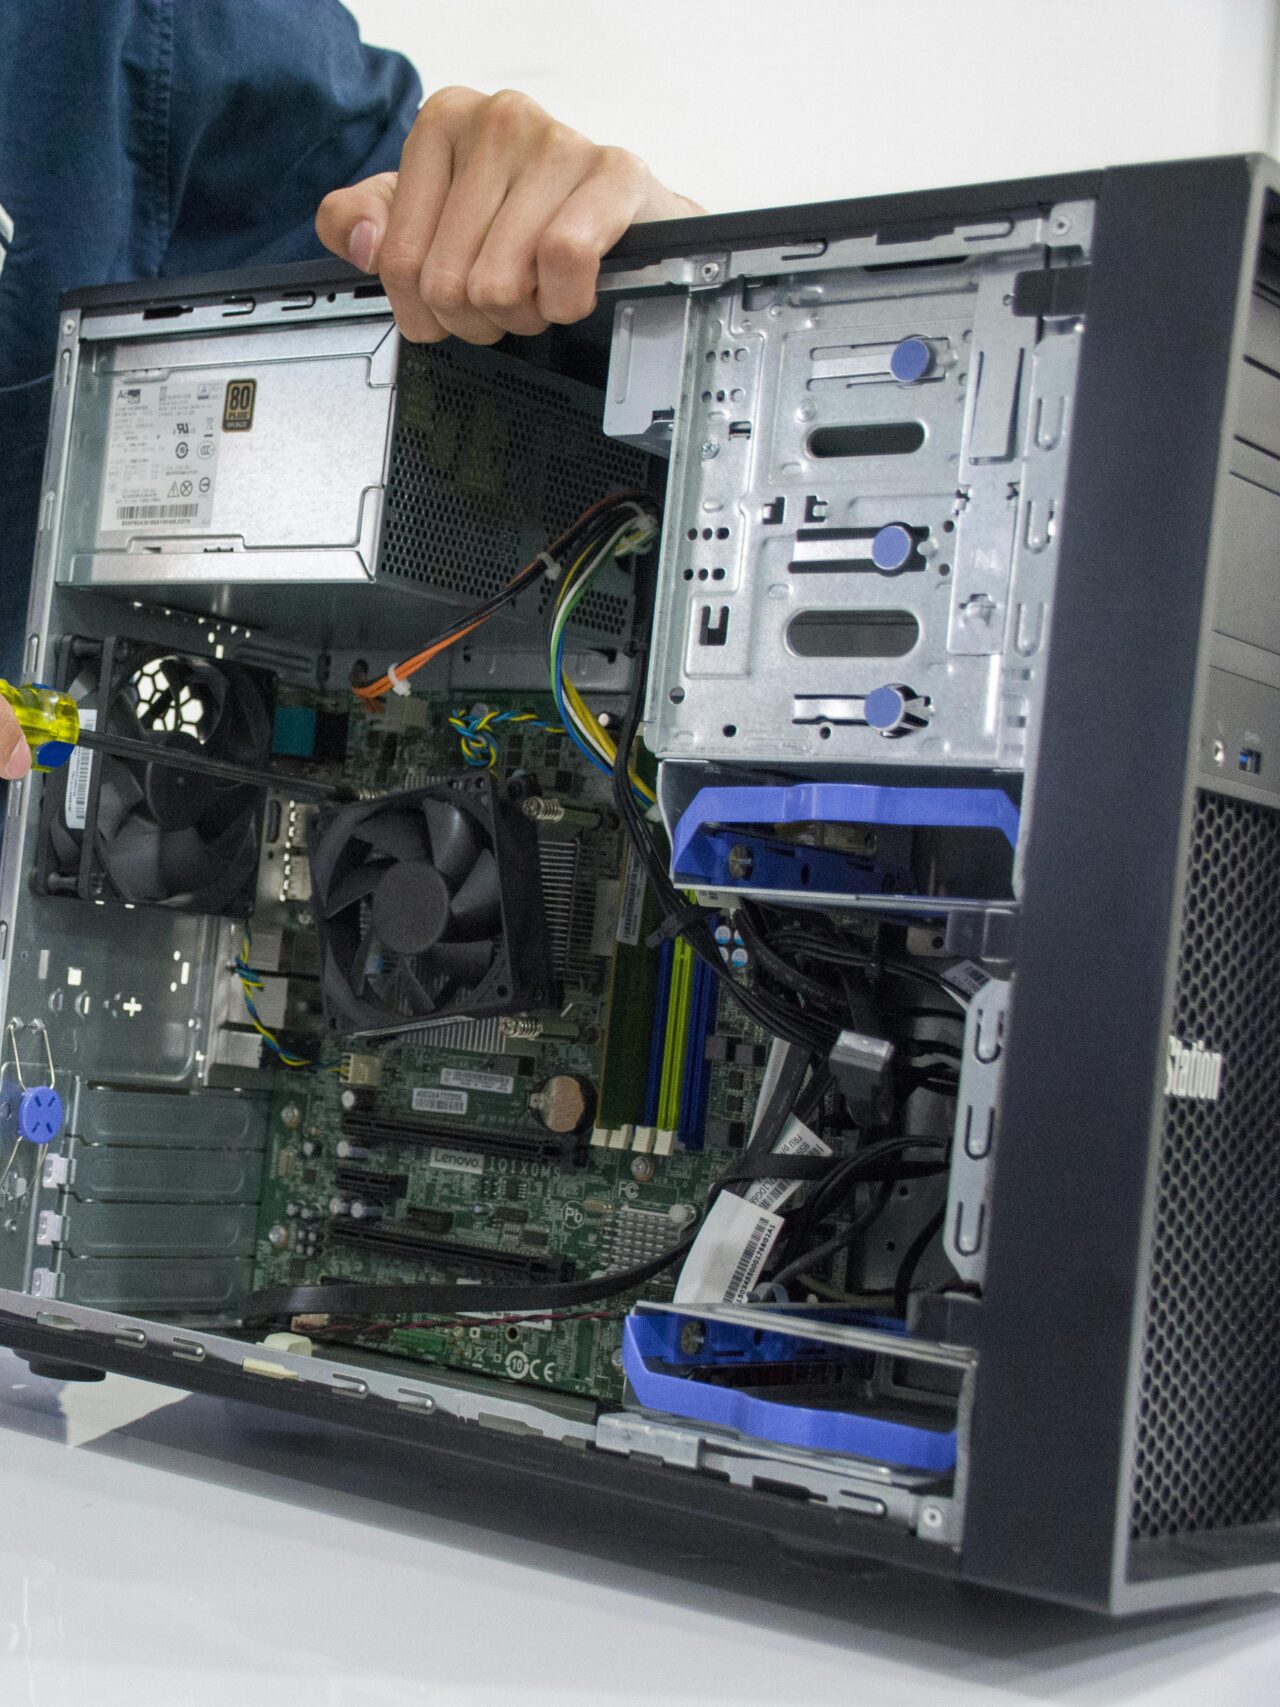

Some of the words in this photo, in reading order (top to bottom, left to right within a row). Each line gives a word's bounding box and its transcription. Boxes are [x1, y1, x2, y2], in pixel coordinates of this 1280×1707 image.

[230, 386, 251, 410] 80
[434, 1150, 479, 1168] Lenovo
[565, 1207, 583, 1223] Pb
[529, 1359, 556, 1383] CE
